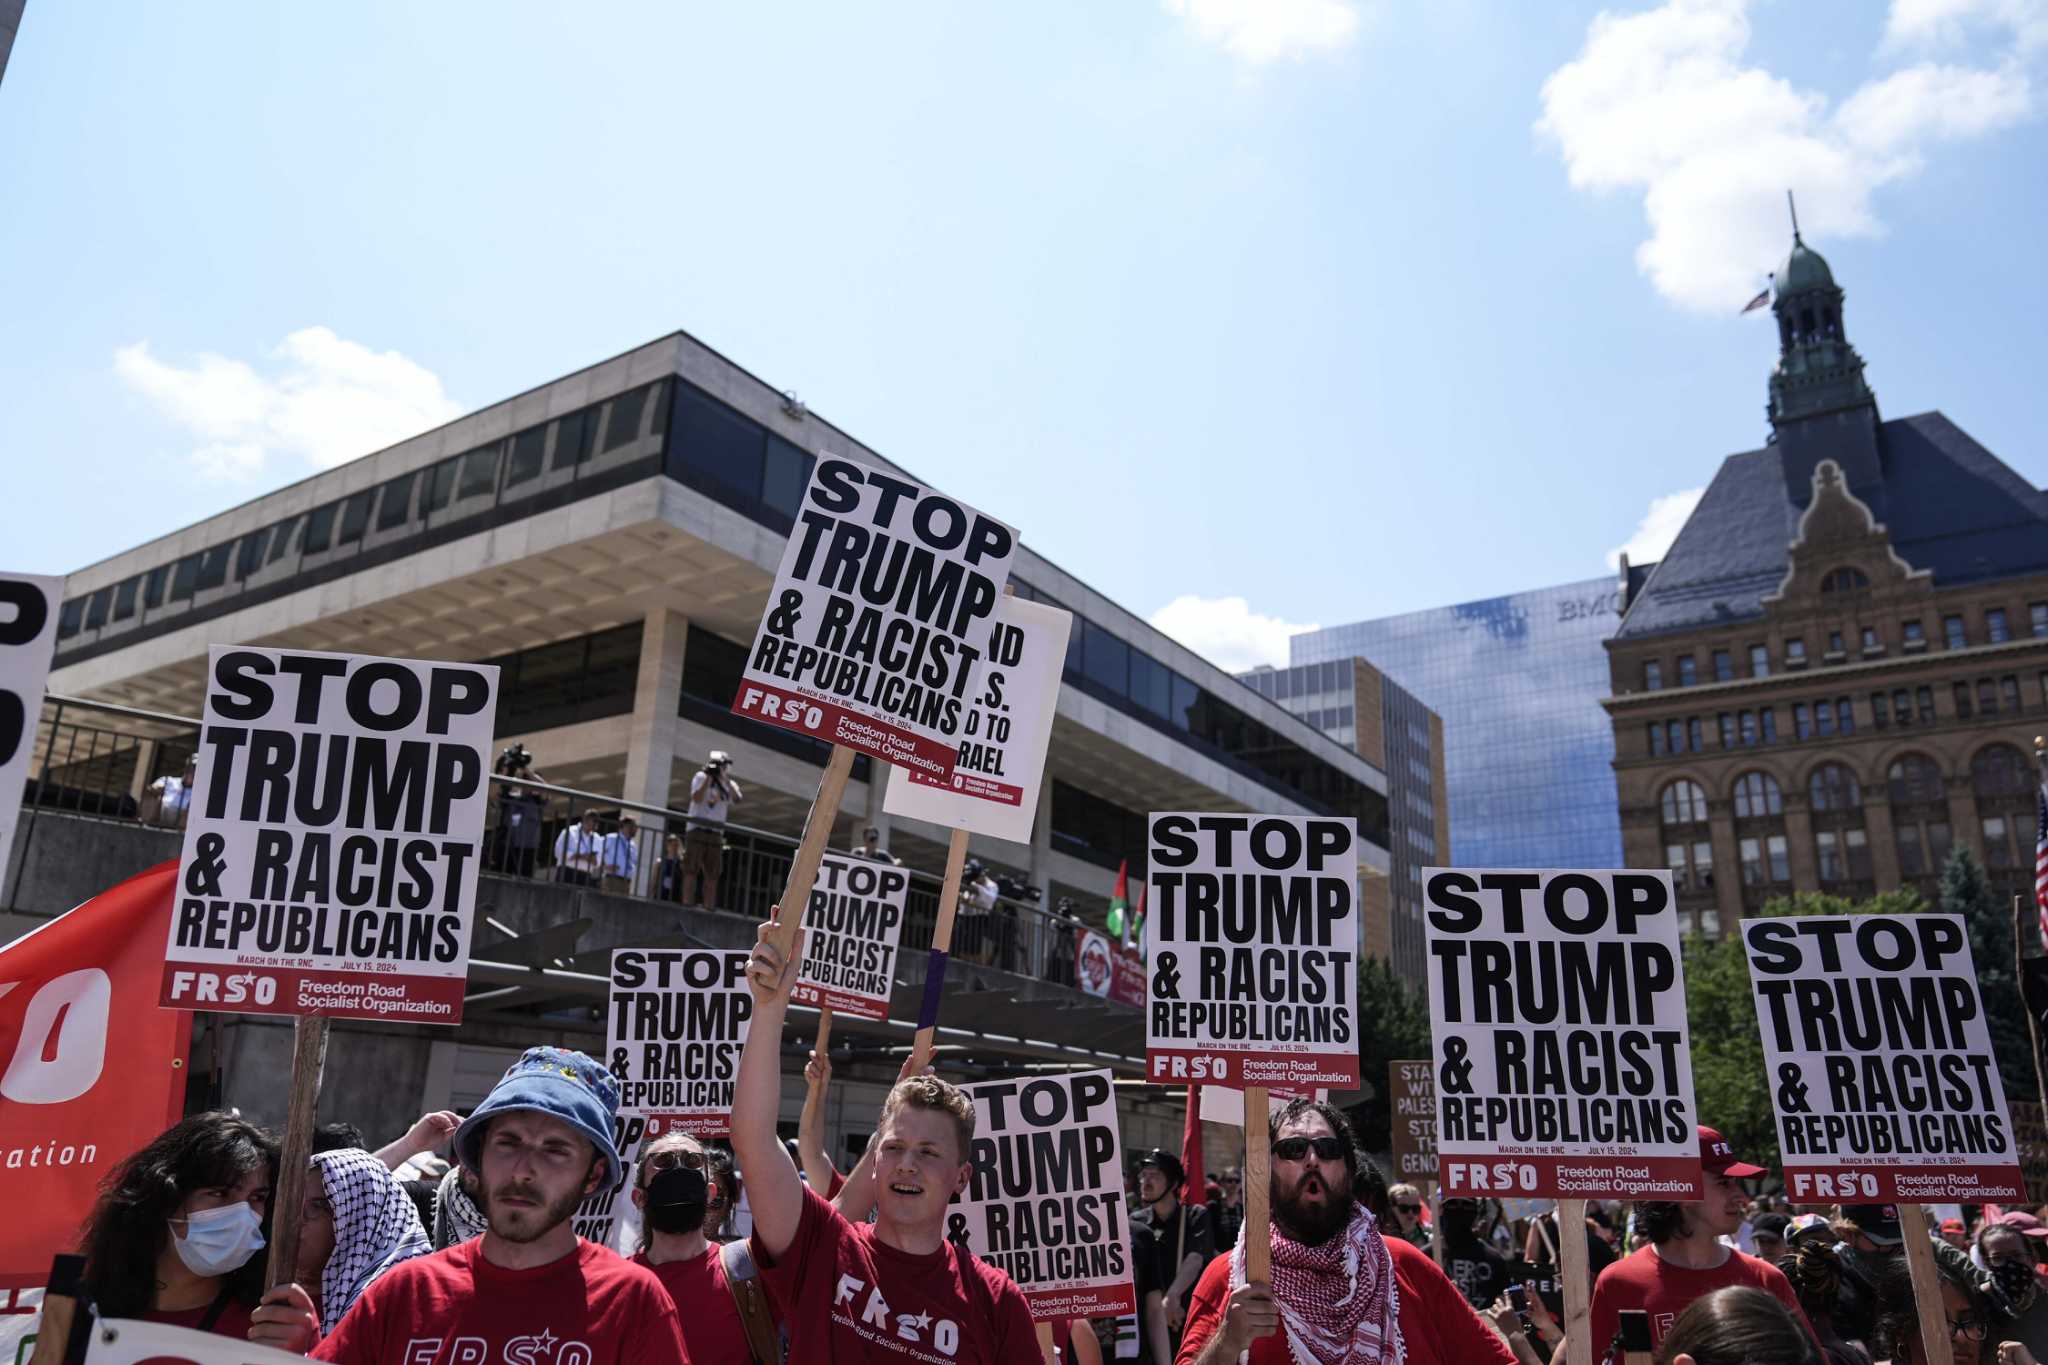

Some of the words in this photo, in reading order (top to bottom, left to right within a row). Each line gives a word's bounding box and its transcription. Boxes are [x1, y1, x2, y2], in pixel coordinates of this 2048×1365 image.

[810, 460, 1012, 565] STOP
[792, 509, 996, 639] TRUMP
[767, 589, 803, 638] &
[815, 595, 979, 699] RACIST
[986, 622, 1025, 667] ND
[211, 651, 489, 735] STOP
[752, 634, 961, 735] REPUBLICANS
[975, 671, 1009, 712] .S.
[742, 688, 823, 729] FRSO
[796, 686, 818, 700] MARCH
[819, 692, 828, 701] ON
[828, 695, 840, 706] THE
[841, 698, 854, 709] RNC
[872, 710, 887, 721] JULY
[896, 719, 912, 730] 2024
[838, 715, 886, 741] Freedom
[888, 734, 916, 751] Road
[986, 713, 1011, 743] TO
[835, 726, 880, 751] Socialist
[882, 744, 945, 775] Organization
[956, 740, 1005, 776] RAEL
[205, 726, 481, 834] TRUMP
[1151, 815, 1351, 871] STOP
[185, 833, 227, 897] &
[250, 829, 473, 912] RACIST
[814, 860, 905, 899] TOP
[806, 893, 899, 942] RUMP
[1152, 872, 1350, 946] TRUMP
[1427, 872, 1667, 934] STOP
[176, 898, 461, 963] REPUBLICANS
[1747, 918, 1963, 974] STOP
[236, 955, 266, 965] MARCH
[267, 957, 279, 966] ON
[281, 958, 296, 967] THE
[298, 959, 313, 968] RNC
[341, 960, 361, 970] JULY
[364, 962, 373, 971] 15,
[376, 963, 397, 972] 2024
[613, 952, 748, 988] STOP
[810, 931, 894, 975] RACIST
[171, 970, 277, 1005] FRSO
[299, 979, 365, 995] Freedom
[367, 982, 405, 997] Road
[790, 985, 818, 1002] RSO
[799, 958, 887, 995] PUBLICANS
[1152, 951, 1181, 999] &
[1201, 947, 1351, 1004] RACIST
[1431, 940, 1674, 1025] TRUMP
[297, 994, 359, 1009] Socialist
[362, 997, 451, 1014] Organization
[613, 992, 752, 1041] TRUMP
[1152, 1001, 1350, 1043] REPUBLICANS
[1757, 977, 1976, 1052] TRUMP
[610, 1042, 630, 1080] &
[1153, 1055, 1228, 1079] FRSO
[1243, 1059, 1288, 1070] Freedom
[1290, 1060, 1317, 1071] Road
[1243, 1070, 1286, 1081] Socialist
[1288, 1071, 1351, 1084] Organization
[1401, 1065, 1434, 1080] STA
[1440, 1035, 1475, 1094] &
[1493, 1030, 1681, 1096] RACIST
[617, 1081, 735, 1107] EPUBLICAN
[1777, 1062, 1812, 1113] &
[1825, 1054, 1996, 1113] RACIST
[671, 1119, 703, 1127] Freedom
[704, 1119, 723, 1127] Road
[960, 1075, 1110, 1132] TOP
[1398, 1097, 1435, 1115] PALES
[1442, 1097, 1688, 1143] REPUBLICANS
[1415, 1137, 1438, 1152] TH
[1498, 1145, 1523, 1154] MARCH
[1525, 1146, 1534, 1154] ON
[1536, 1146, 1549, 1154] THE
[1551, 1146, 1565, 1154] RNC
[1587, 1146, 1605, 1155] JULY
[1606, 1147, 1618, 1156] 15,
[1620, 1147, 1638, 1155] 2024
[1712, 1142, 1733, 1156] FR
[1782, 1114, 2007, 1155] REPUBLICANS
[0, 1144, 97, 1169] ation
[949, 1126, 1115, 1204] RUMP
[1401, 1154, 1439, 1173] GENO
[1448, 1161, 1537, 1190] FRSO
[1556, 1165, 1613, 1177] Freedom
[1615, 1166, 1649, 1178] Road
[1839, 1157, 1863, 1165] MARCH
[1864, 1157, 1873, 1165] ON
[1874, 1157, 1886, 1165] THE
[1887, 1157, 1900, 1165] RNC
[1921, 1157, 1937, 1165] JULY
[1939, 1157, 1948, 1166] 15,
[1950, 1157, 1966, 1165] 2024
[1557, 1178, 1611, 1191] Socialist
[1613, 1180, 1693, 1194] Organization
[1793, 1172, 1879, 1197] FRSO
[1894, 1173, 1946, 1185] Freedom
[1949, 1173, 1978, 1185] Road
[1896, 1186, 1946, 1197] Socialist
[1948, 1186, 2016, 1199] Organization
[947, 1212, 972, 1251] &
[985, 1192, 1120, 1252] RACIST
[834, 1272, 959, 1356] FRSO
[1030, 1298, 1071, 1308] Freedom
[1073, 1294, 1097, 1304] Road
[1031, 1307, 1070, 1318] Socialist
[1071, 1302, 1128, 1315] Organization
